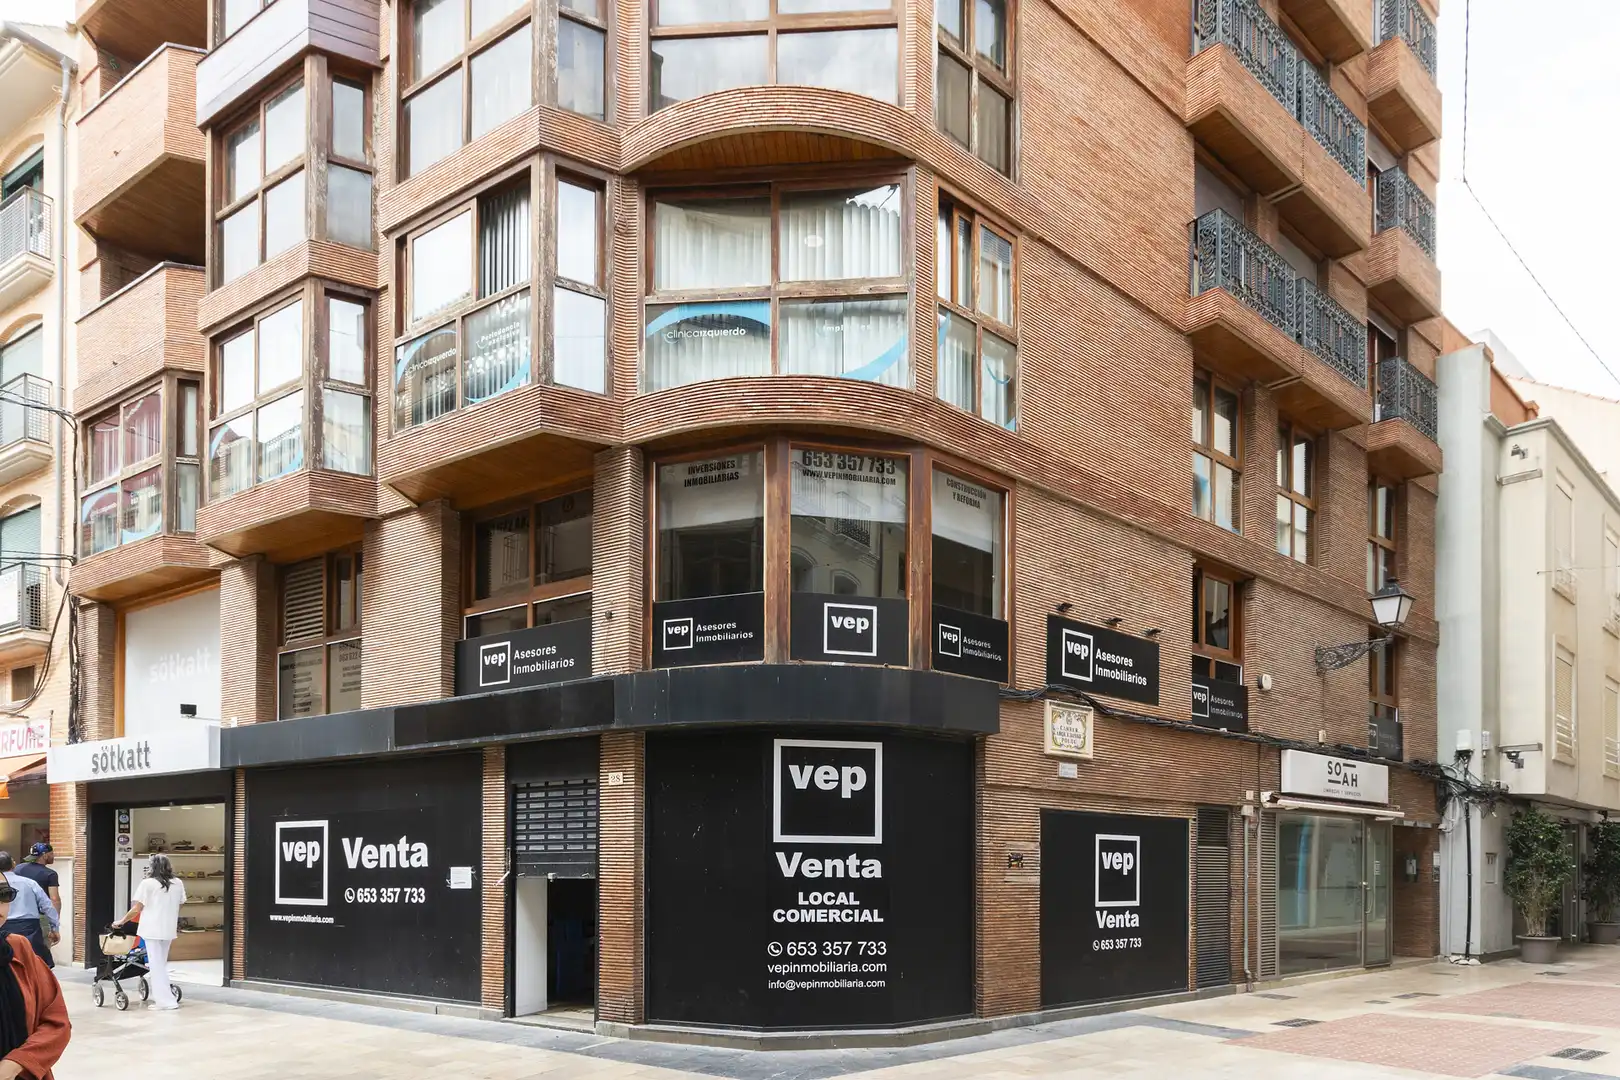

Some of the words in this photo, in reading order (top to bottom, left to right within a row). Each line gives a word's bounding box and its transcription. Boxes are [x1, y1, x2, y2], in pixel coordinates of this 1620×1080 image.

[687, 460, 736, 475] INVERSIONES
[802, 450, 833, 469] 653
[837, 452, 864, 471] 357
[868, 455, 896, 475] 733
[684, 471, 740, 487] INMOBILIARIAS
[802, 469, 896, 486] WWW.VEPINMOBILIARIA.COM
[956, 493, 981, 510] REFORMA
[667, 624, 689, 635] vep
[696, 621, 737, 632] Asesores
[831, 615, 870, 634] vep
[695, 630, 754, 643] Inmobiliarios
[942, 630, 958, 643] vep
[963, 636, 991, 649] Asesores
[513, 645, 557, 660] Asesores
[963, 646, 1002, 661] Inmobiliarios
[1066, 640, 1089, 659] vep
[484, 651, 506, 666] vep
[1095, 648, 1133, 667] Asesores
[513, 656, 575, 675] Inmobiliarios
[1095, 664, 1148, 686] Inmobiliarios
[1193, 691, 1207, 703] vep
[1210, 695, 1235, 707] Asesores
[1210, 706, 1243, 719] Inmobiliarios
[91, 740, 151, 775] sötkatt
[788, 764, 867, 798] vep
[282, 840, 320, 868] vep
[341, 835, 429, 869] Venta
[775, 851, 882, 879] Venta
[1101, 851, 1134, 875] vep
[356, 888, 377, 903] 653
[380, 887, 401, 903] 357
[403, 887, 426, 903] 733
[798, 891, 860, 906] LOCAL
[269, 914, 335, 925] www.vepinmobiliaria.com
[772, 909, 884, 923] COMERCIAL
[1095, 910, 1140, 929] Venta
[786, 941, 817, 956] 653
[822, 941, 852, 956] 357
[857, 941, 887, 956] 733
[1100, 939, 1114, 950] 653
[1115, 938, 1128, 949] 357
[1129, 937, 1142, 948] 733
[767, 961, 887, 976] vepinmobiliaria.com
[768, 978, 886, 991] info@vepinmobiliaria.com
